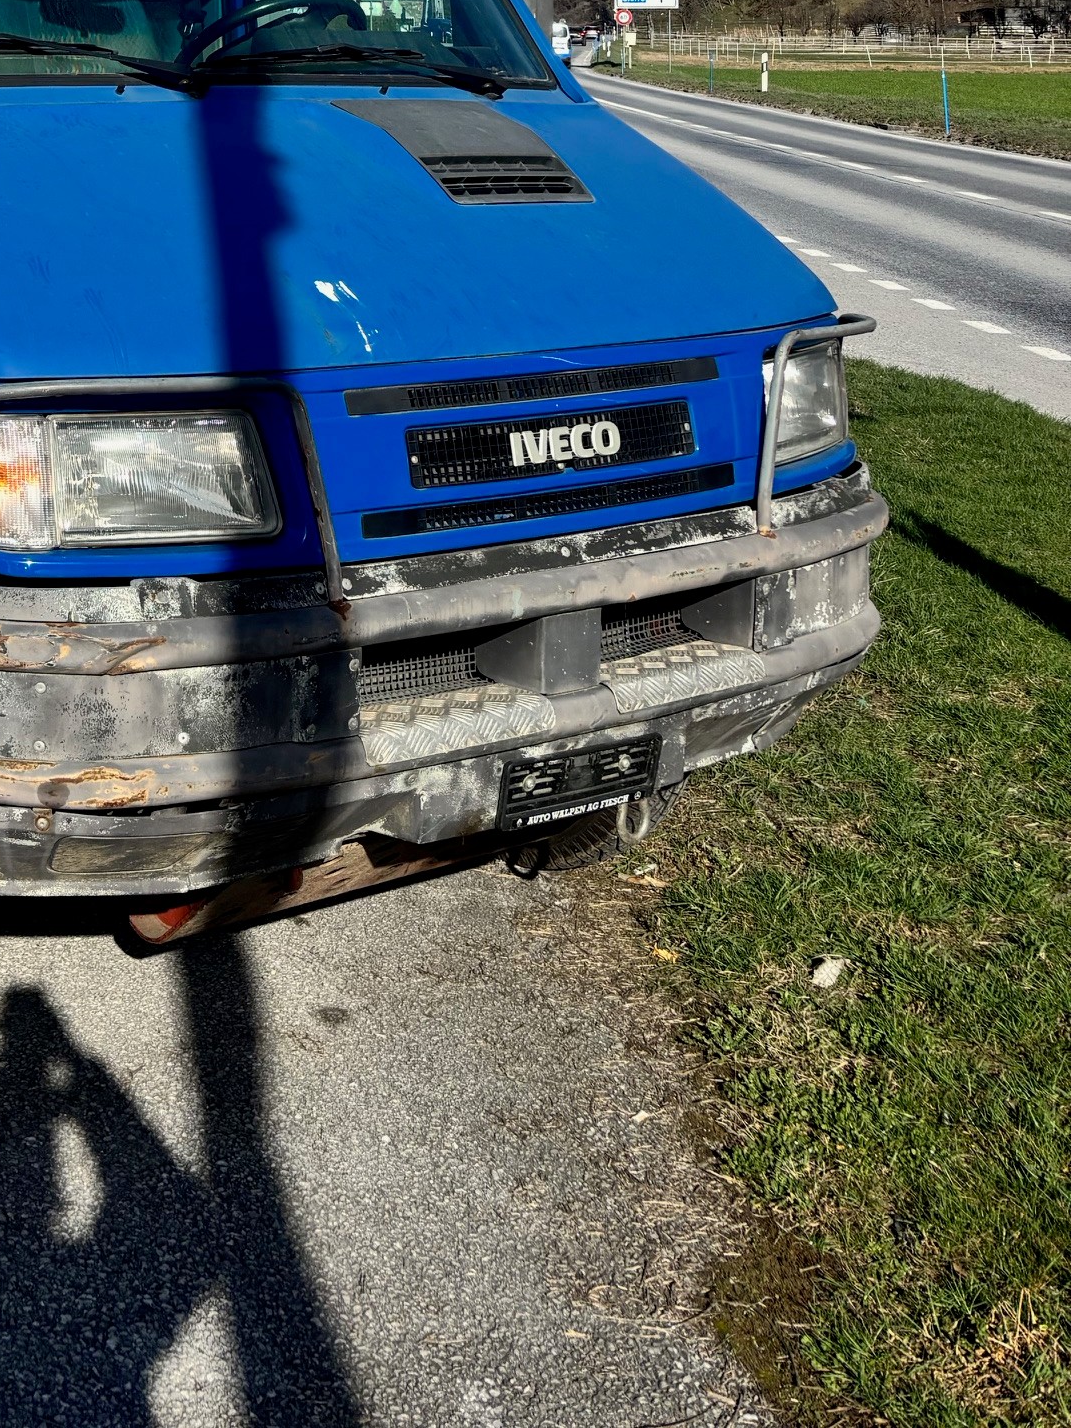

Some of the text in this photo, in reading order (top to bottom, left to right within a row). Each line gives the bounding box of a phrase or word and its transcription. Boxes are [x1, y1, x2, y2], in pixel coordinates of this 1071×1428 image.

[509, 420, 621, 467] IVECO
[527, 794, 630, 825] AUTO WALPEN AG FIESCH
